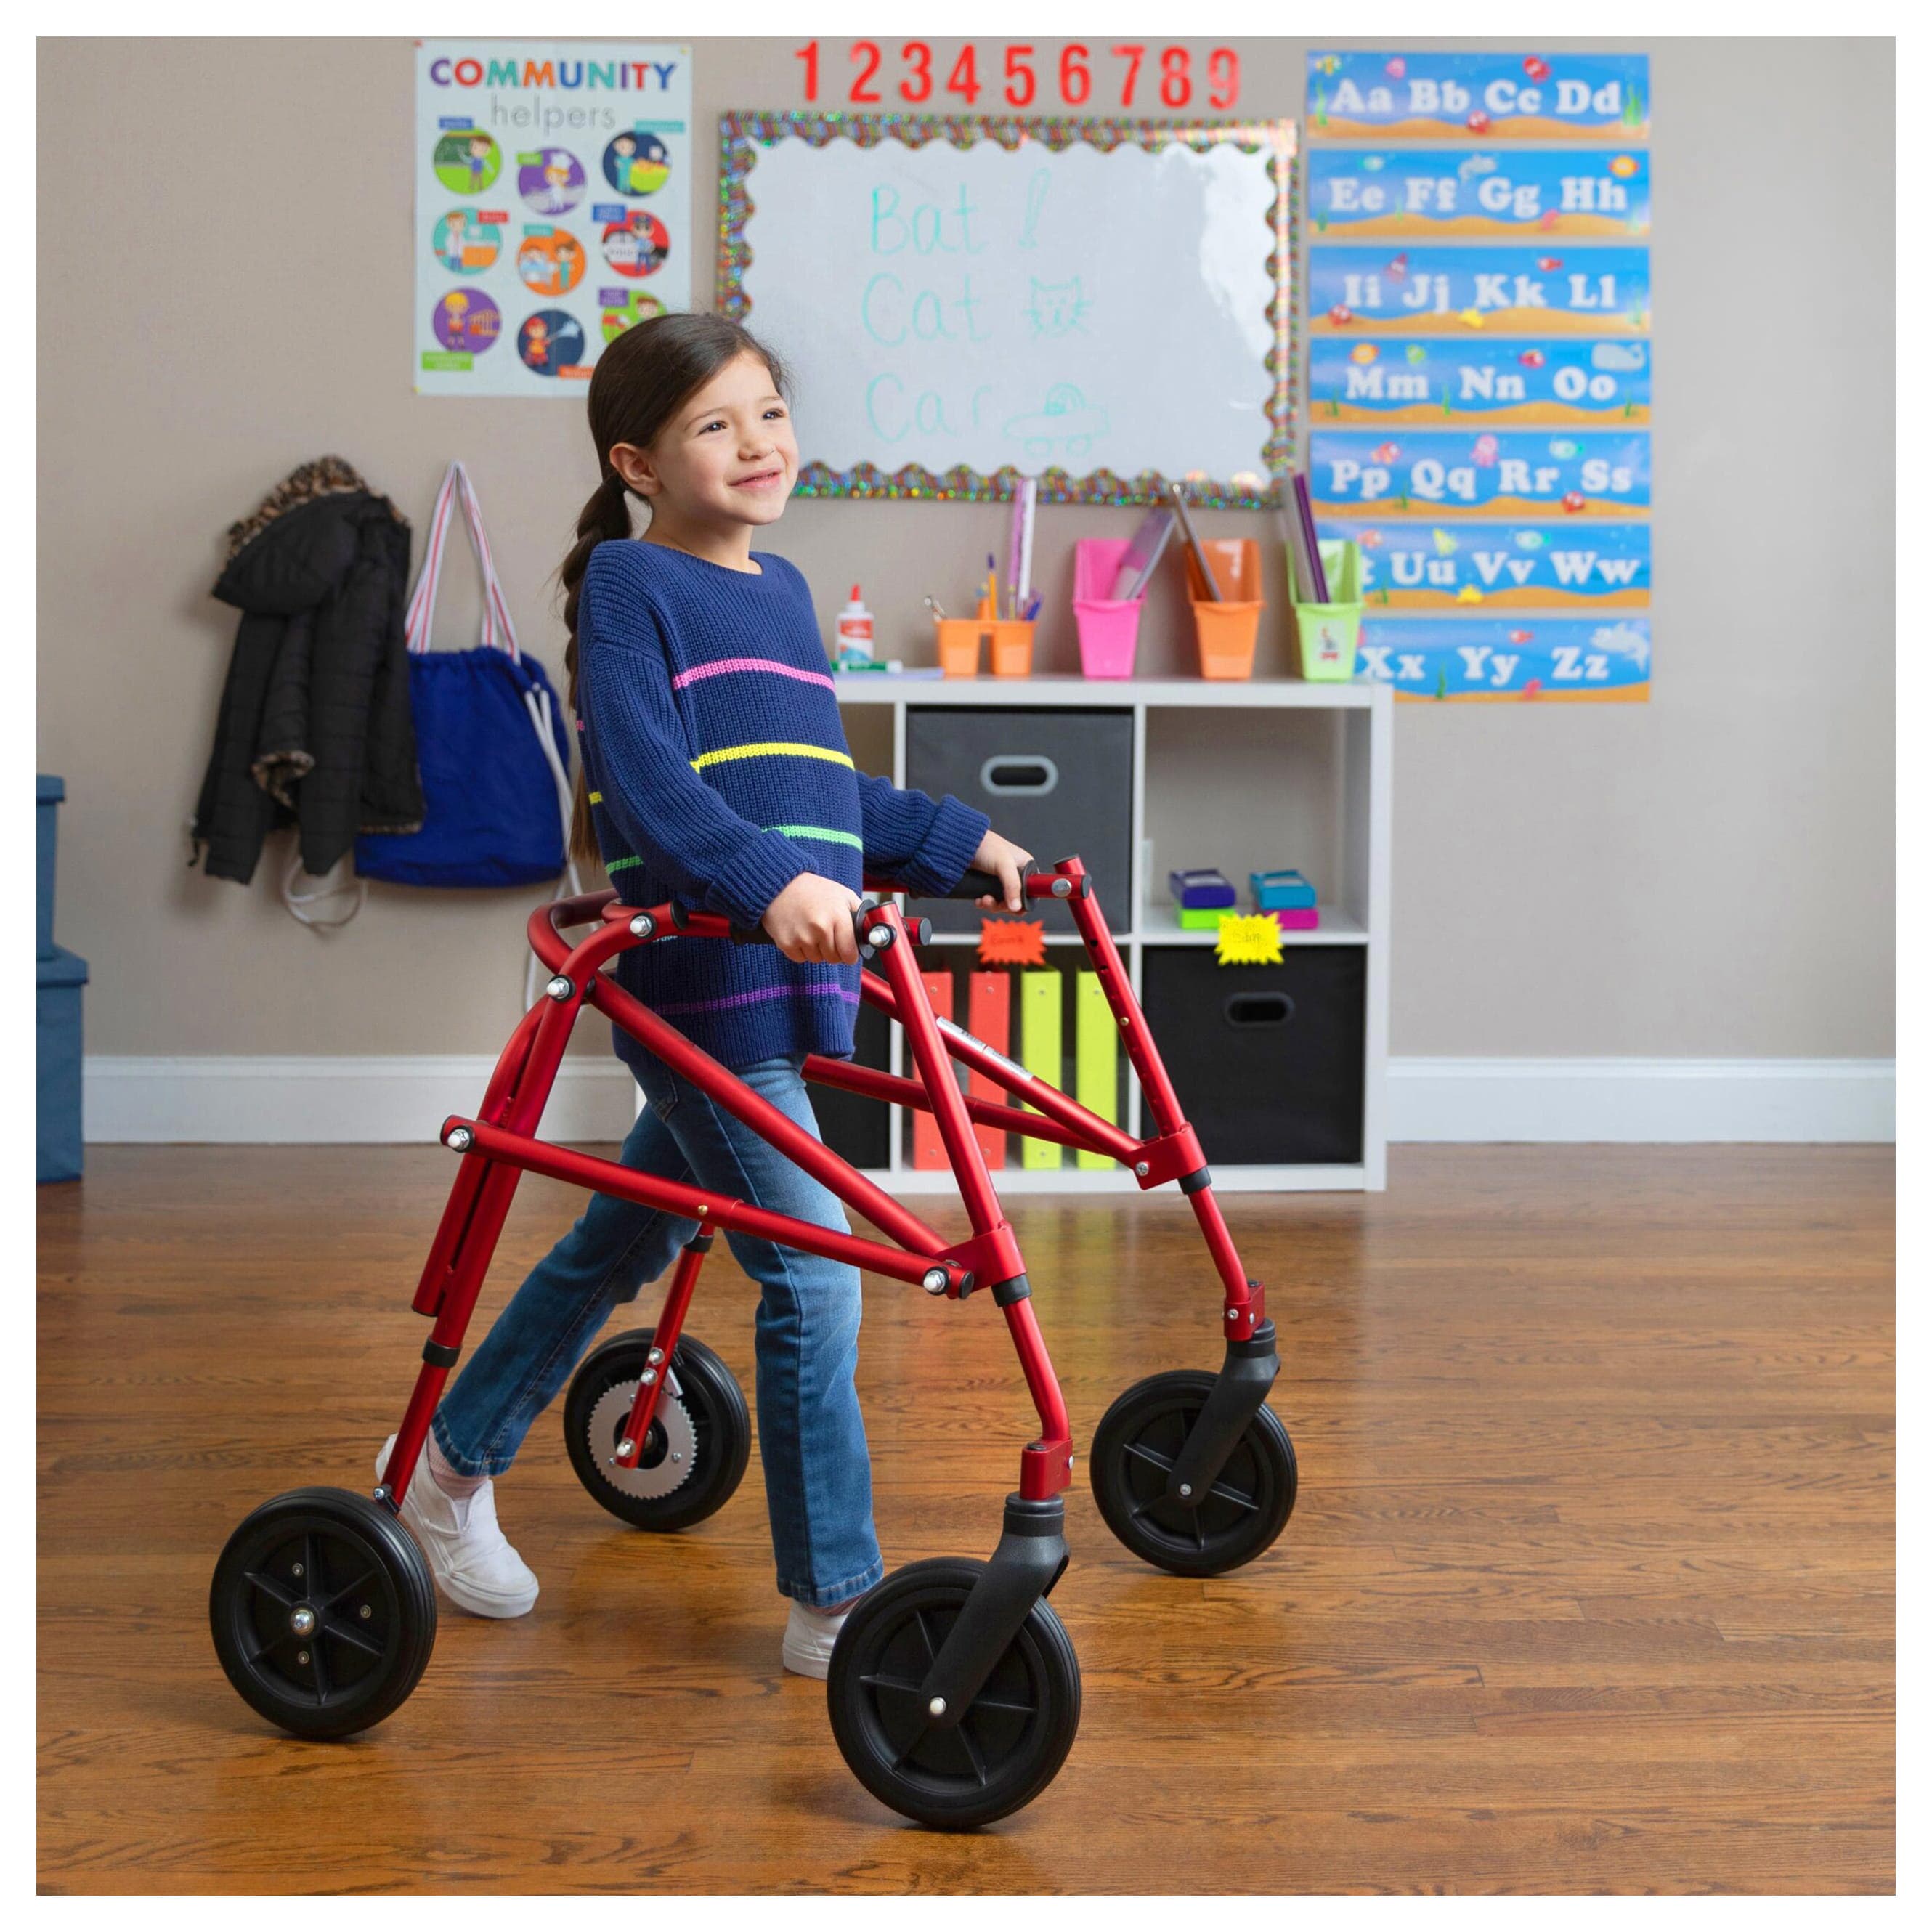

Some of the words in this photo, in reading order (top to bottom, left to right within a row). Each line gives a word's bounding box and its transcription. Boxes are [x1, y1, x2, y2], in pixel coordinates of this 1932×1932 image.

[430, 57, 677, 91] COMMUNITY
[795, 39, 819, 102] 1
[848, 38, 882, 105] 2
[898, 39, 934, 104] 3
[946, 43, 981, 105] 4
[1003, 44, 1036, 108] 5
[1058, 43, 1091, 107] 6
[1111, 44, 1146, 108] 7
[1158, 45, 1193, 109] 8
[1206, 46, 1241, 110] 9
[490, 94, 617, 137] helpers
[1330, 78, 1392, 113] Aa
[1408, 79, 1471, 114] Bb
[1484, 79, 1541, 114] Cc
[1555, 80, 1622, 115] Dd
[869, 182, 986, 256] Bat
[1328, 177, 1385, 211] Ee
[1405, 177, 1457, 211] Ff
[1477, 177, 1540, 219] Gg
[1560, 177, 1628, 211] Hh
[861, 272, 994, 348] Cat
[1344, 274, 1382, 309] Ii
[1401, 274, 1450, 314] Jj
[1474, 274, 1547, 309] Kk
[1568, 275, 1617, 309] Ll
[1345, 366, 1430, 400] Mm
[1458, 366, 1526, 400] Nn
[1553, 366, 1618, 401] Oo
[864, 372, 994, 444] Car
[1330, 459, 1391, 499] Pp
[1411, 458, 1477, 500] Qq
[1498, 458, 1560, 493] Rr
[1580, 458, 1633, 493] Ss
[1389, 551, 1457, 585] Uu
[1472, 551, 1535, 585] Vv
[1550, 551, 1641, 585] Ww
[1359, 646, 1425, 680] Xx
[1457, 646, 1520, 686] Yy
[1551, 646, 1609, 680] Zz
